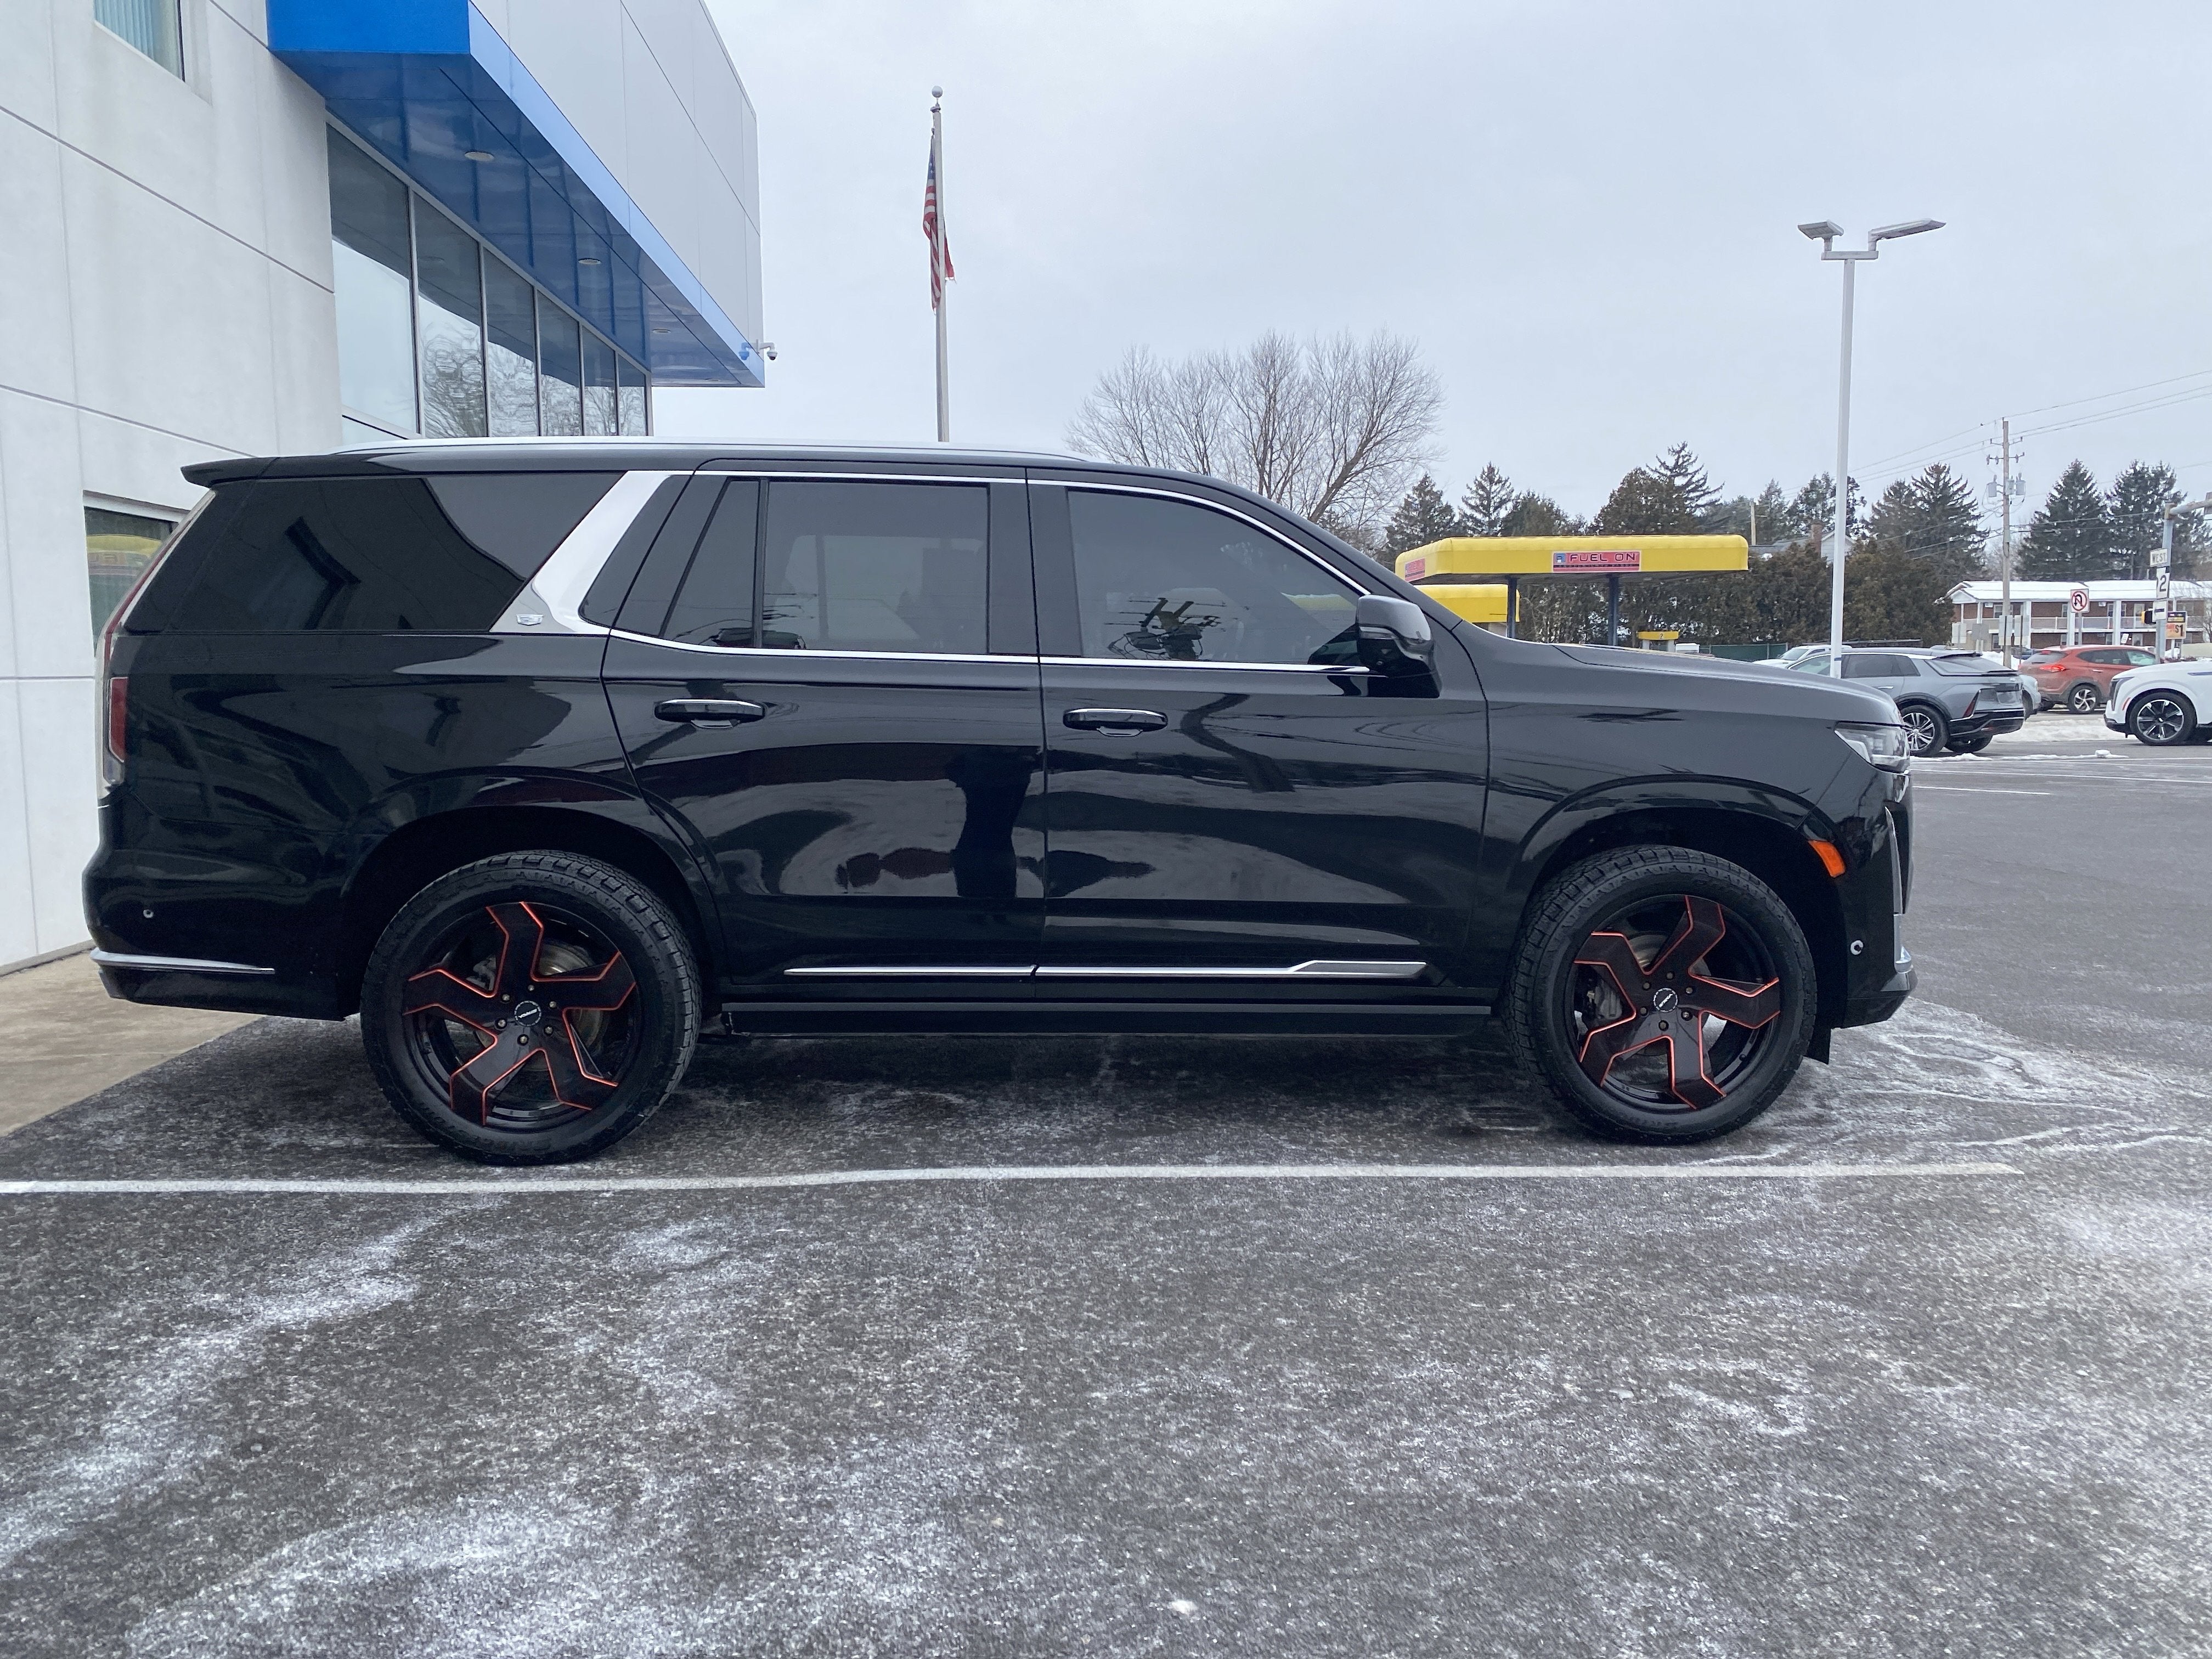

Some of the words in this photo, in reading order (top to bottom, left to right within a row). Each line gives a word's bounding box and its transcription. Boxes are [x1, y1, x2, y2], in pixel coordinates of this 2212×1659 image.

[1570, 554, 1607, 562] FUEL
[1615, 553, 1635, 561] ON
[2152, 552, 2166, 563] WEST
